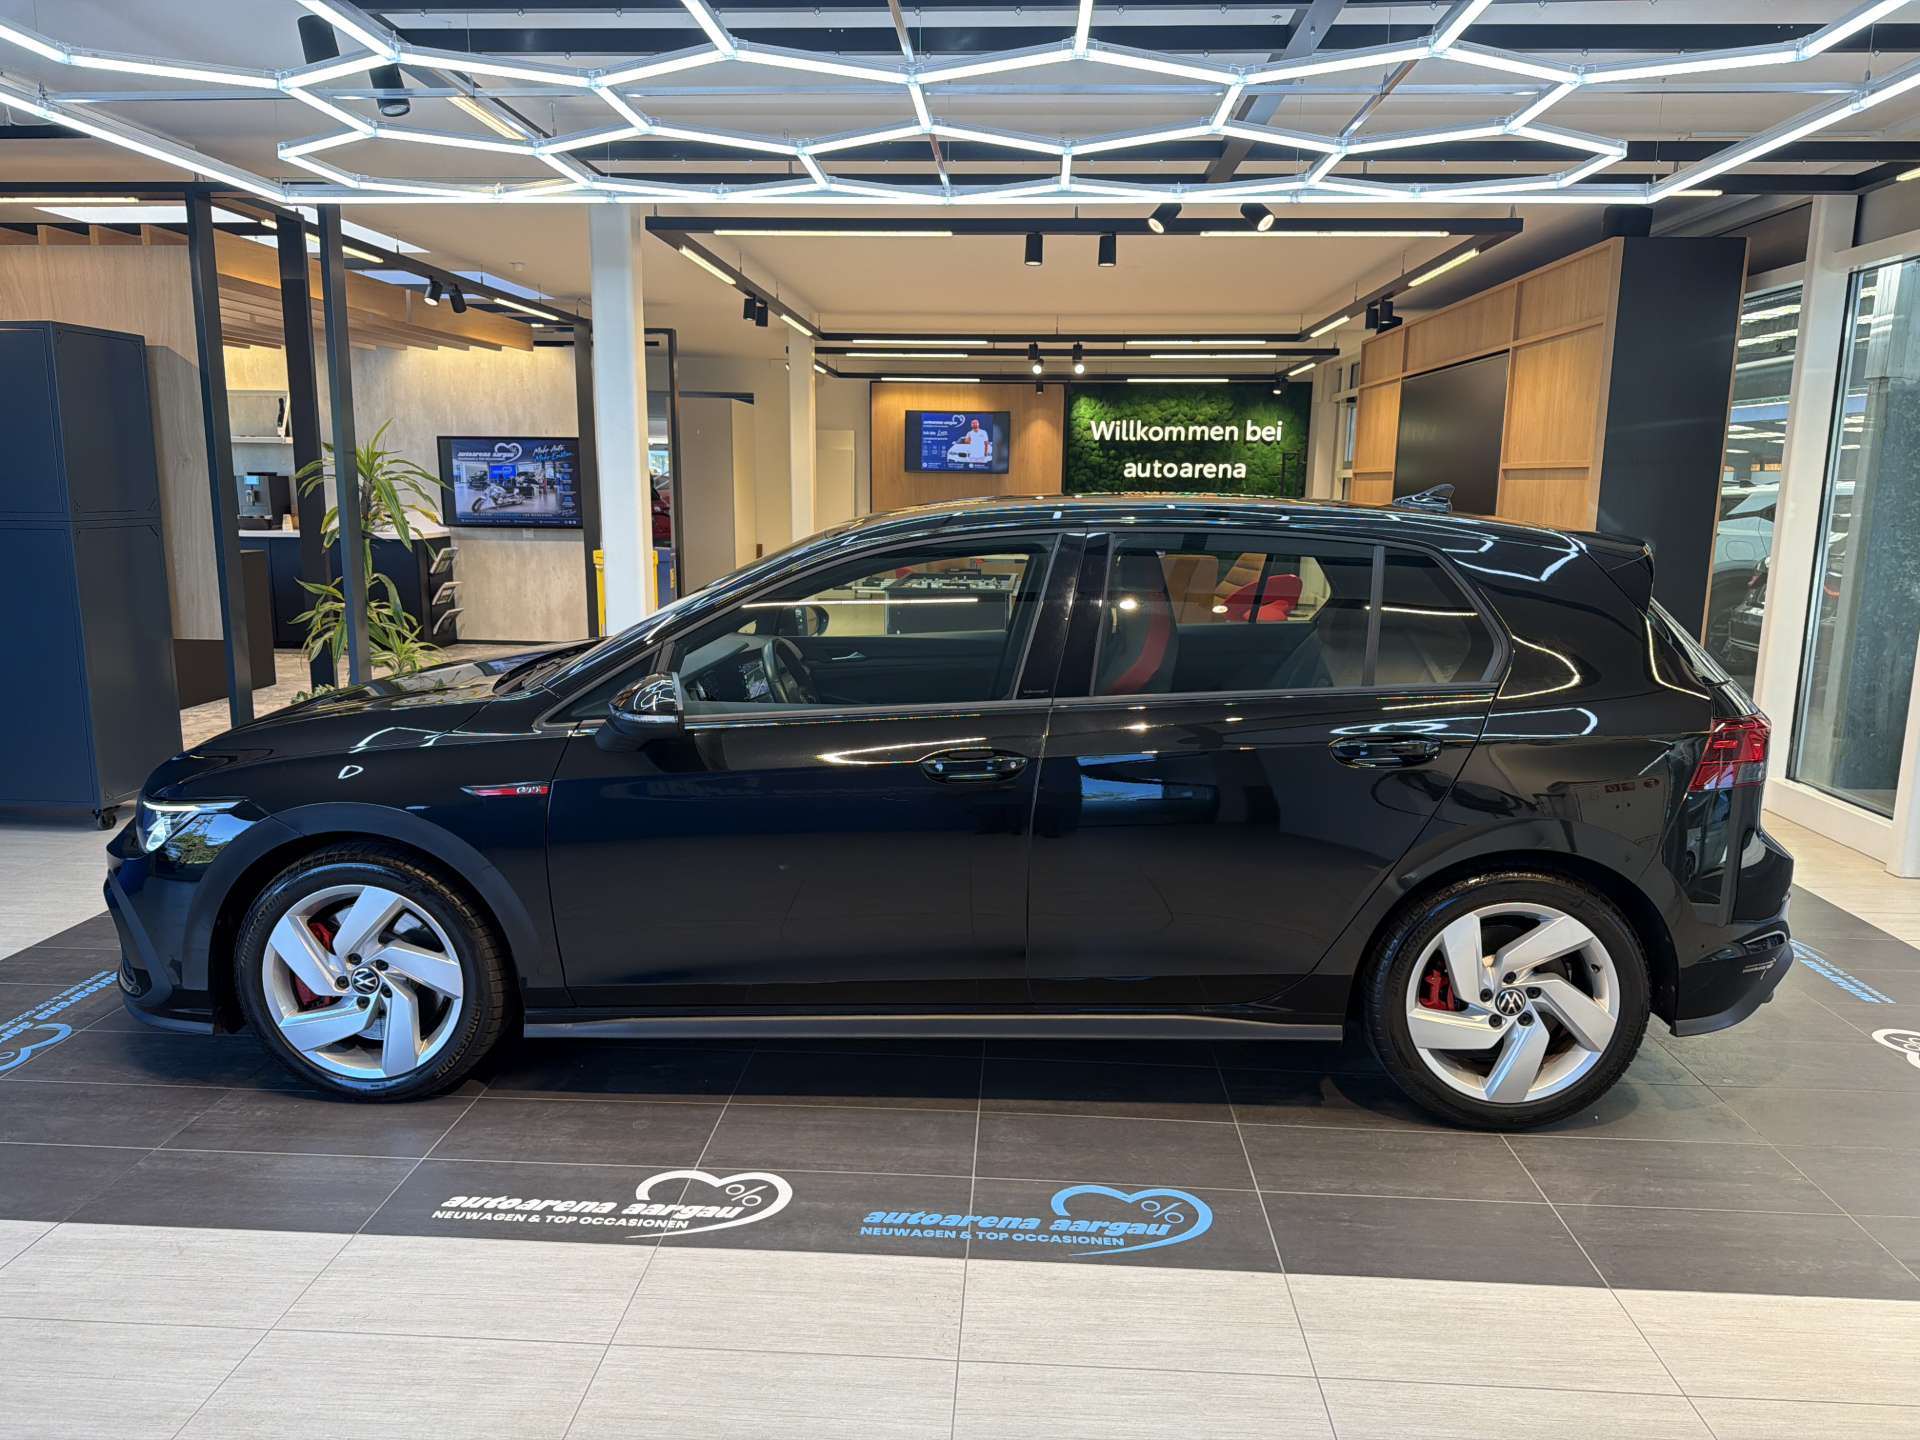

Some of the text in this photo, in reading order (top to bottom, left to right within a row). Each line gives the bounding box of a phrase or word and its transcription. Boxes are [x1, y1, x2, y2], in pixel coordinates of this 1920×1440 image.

[1090, 419, 1283, 442] Willkommen bei
[1123, 459, 1247, 479] autoarena
[441, 1194, 745, 1219] autoarena aargau
[431, 1210, 690, 1230] NEUWAGEN & TOP OCCASIONEN
[863, 1210, 1171, 1237] autoarena aargau
[859, 1226, 1126, 1247] NEUWAGEN & TOP OCCASIONEN
